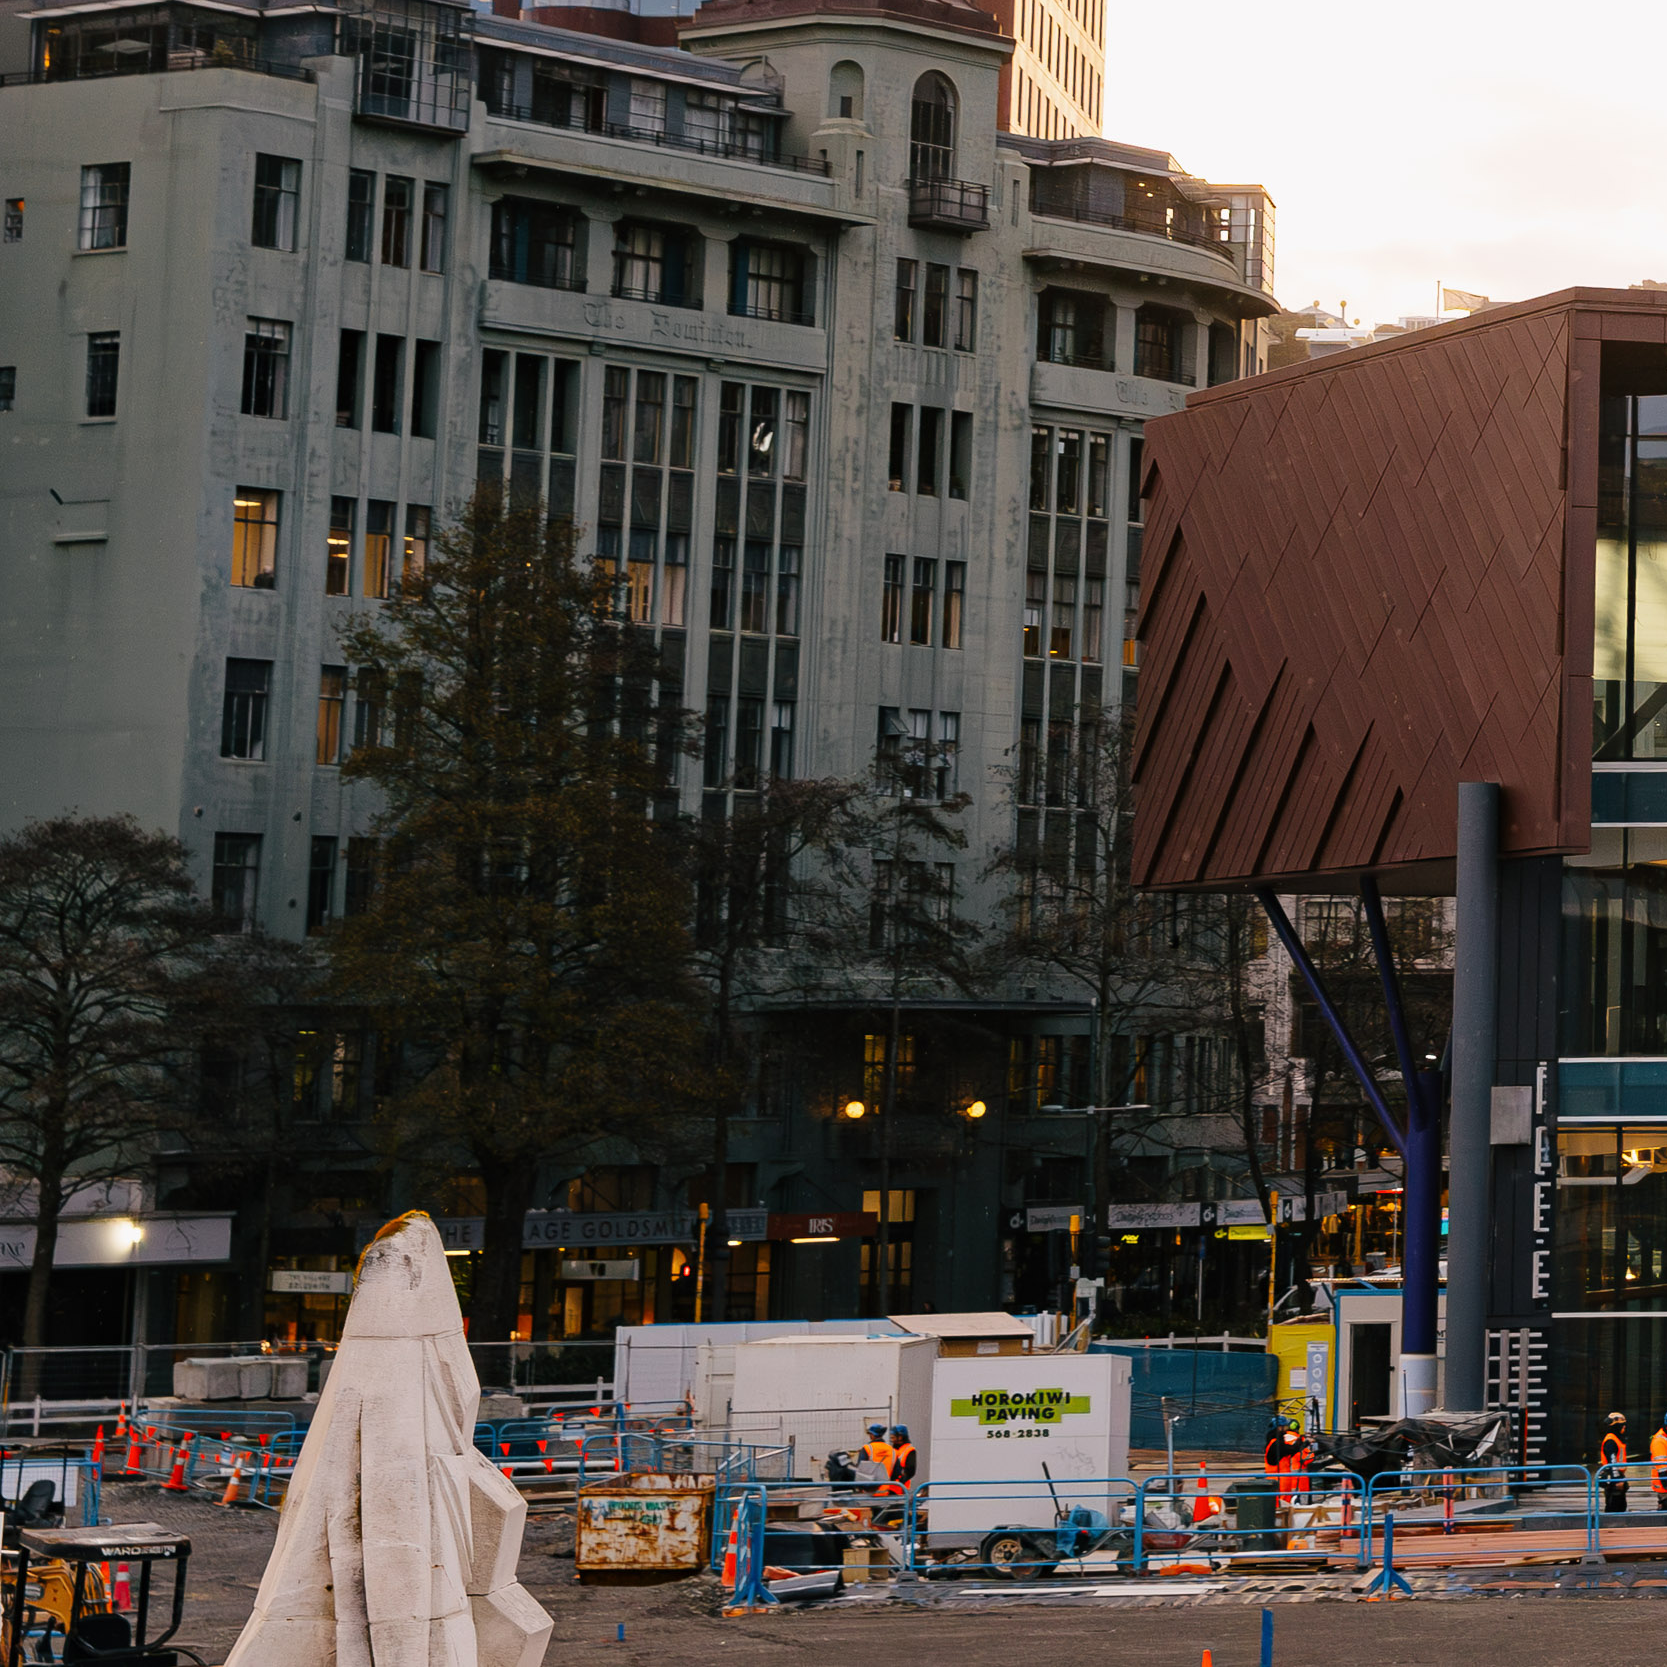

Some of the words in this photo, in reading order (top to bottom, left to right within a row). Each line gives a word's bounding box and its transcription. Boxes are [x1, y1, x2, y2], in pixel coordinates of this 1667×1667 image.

[808, 1217, 834, 1234] IRIS
[971, 1391, 1071, 1407] HOROKIWI
[986, 1407, 1055, 1421] PAVING
